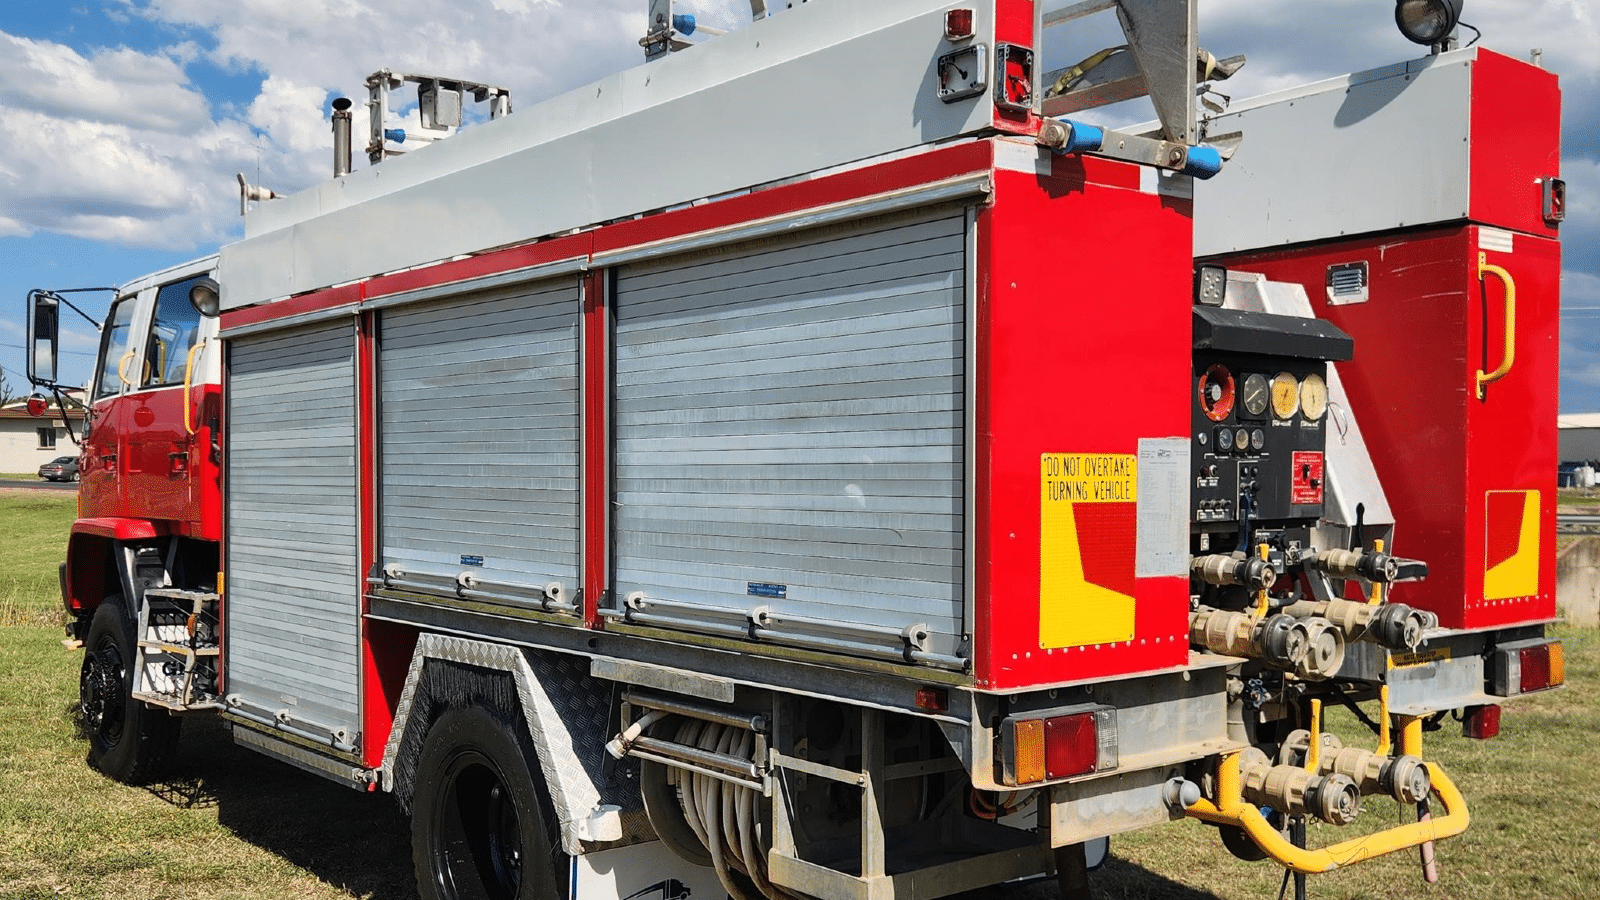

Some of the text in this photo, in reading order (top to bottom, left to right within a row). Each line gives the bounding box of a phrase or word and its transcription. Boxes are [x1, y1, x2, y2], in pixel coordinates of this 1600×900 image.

[1047, 457, 1131, 477] DO NOT OVERTAKE
[1047, 480, 1130, 501] TURNING VEHICLE
